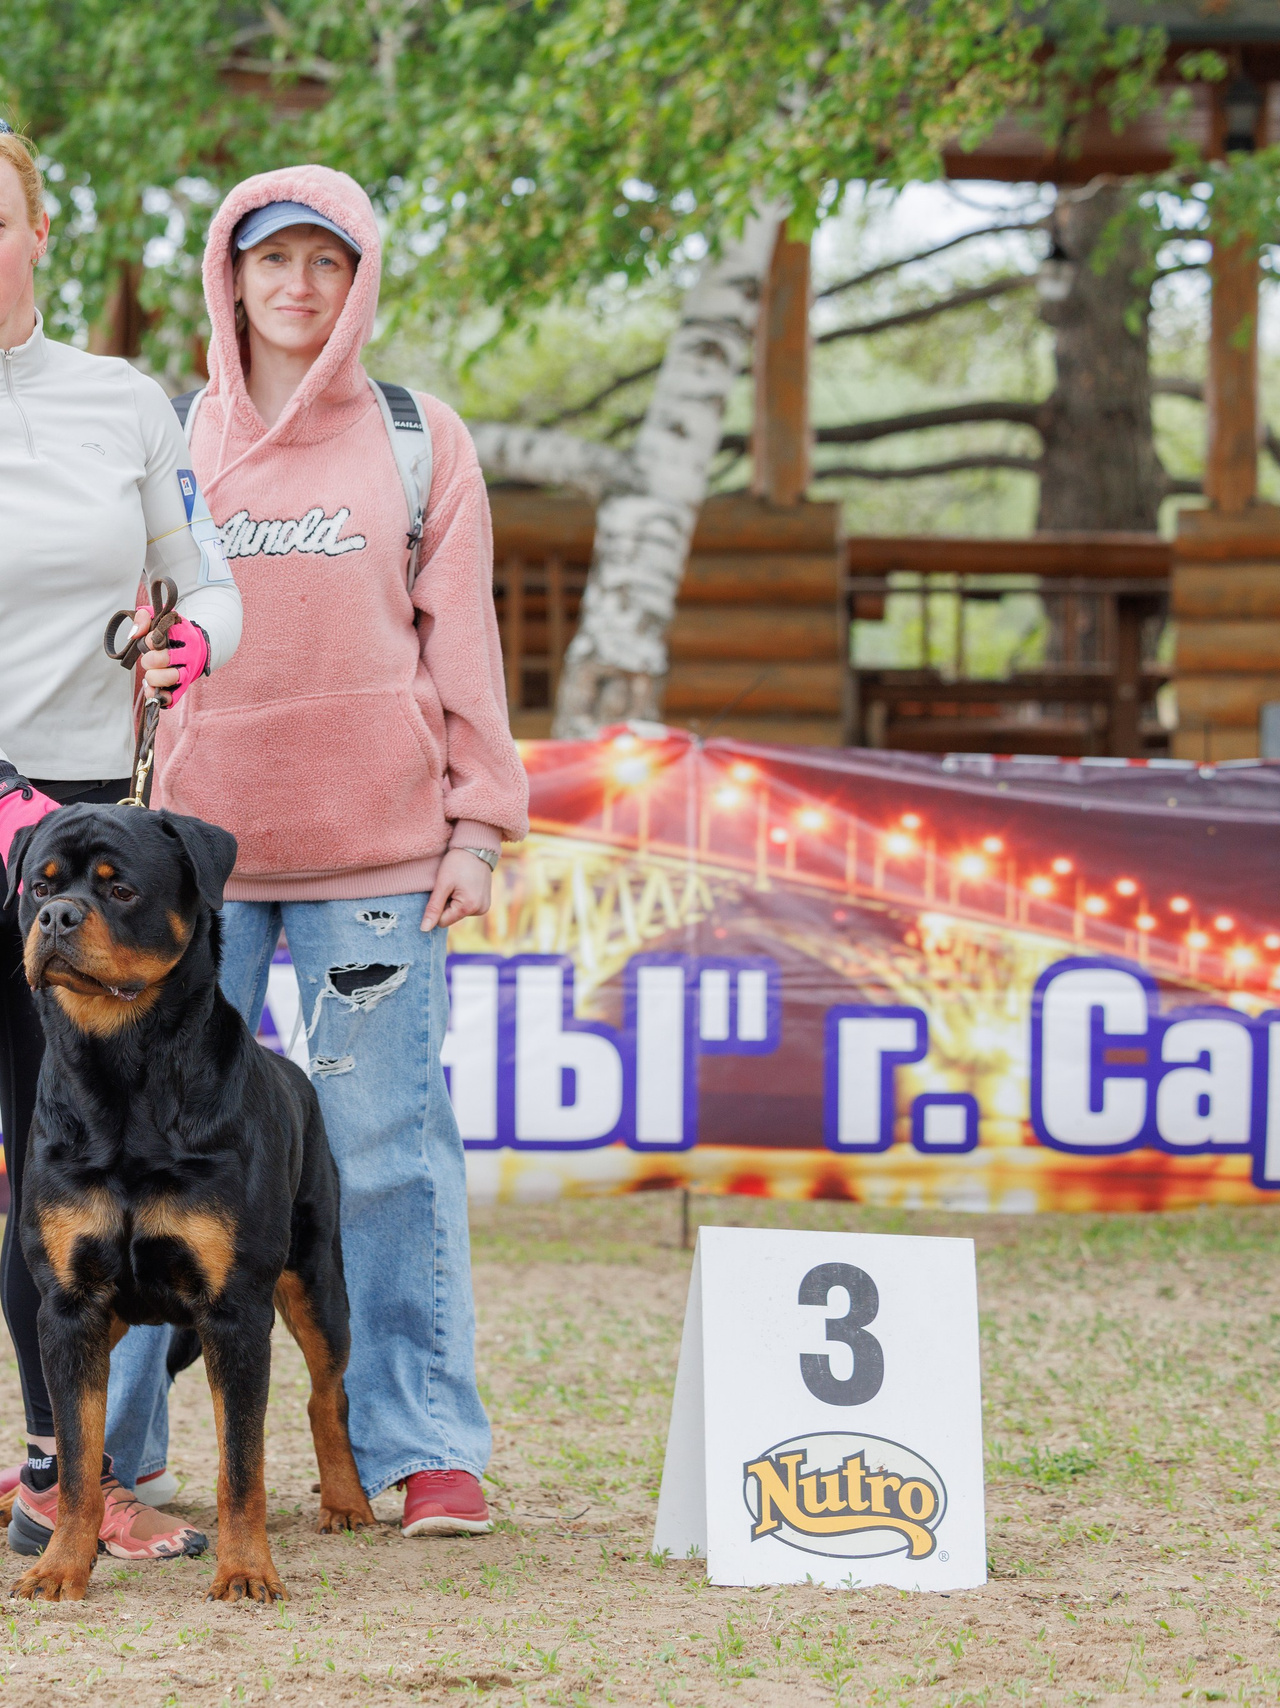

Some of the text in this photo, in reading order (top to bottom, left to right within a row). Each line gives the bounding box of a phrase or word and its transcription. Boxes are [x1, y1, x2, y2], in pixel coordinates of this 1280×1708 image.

[836, 1016, 968, 1146] г.
[797, 1261, 885, 1407] 3
[743, 1450, 939, 1560] Nutro
